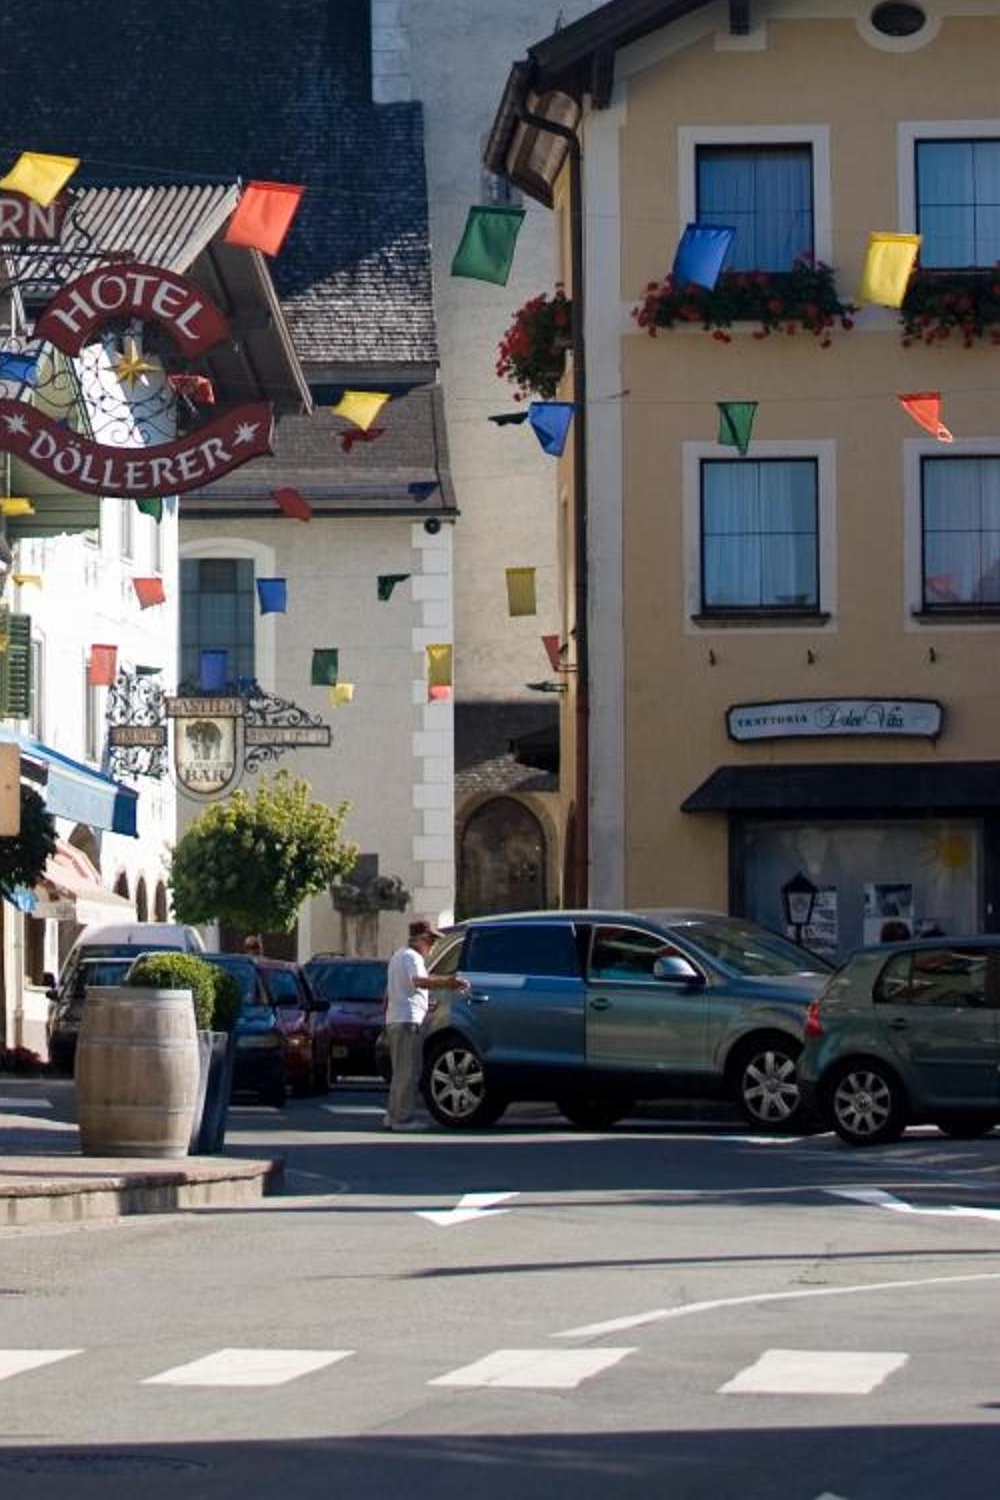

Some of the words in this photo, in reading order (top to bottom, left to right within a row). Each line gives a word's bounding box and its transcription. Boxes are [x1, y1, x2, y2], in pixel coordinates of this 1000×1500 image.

[52, 273, 203, 340] HOTEL
[29, 429, 232, 489] DÖLLERER
[184, 769, 226, 783] BAR
